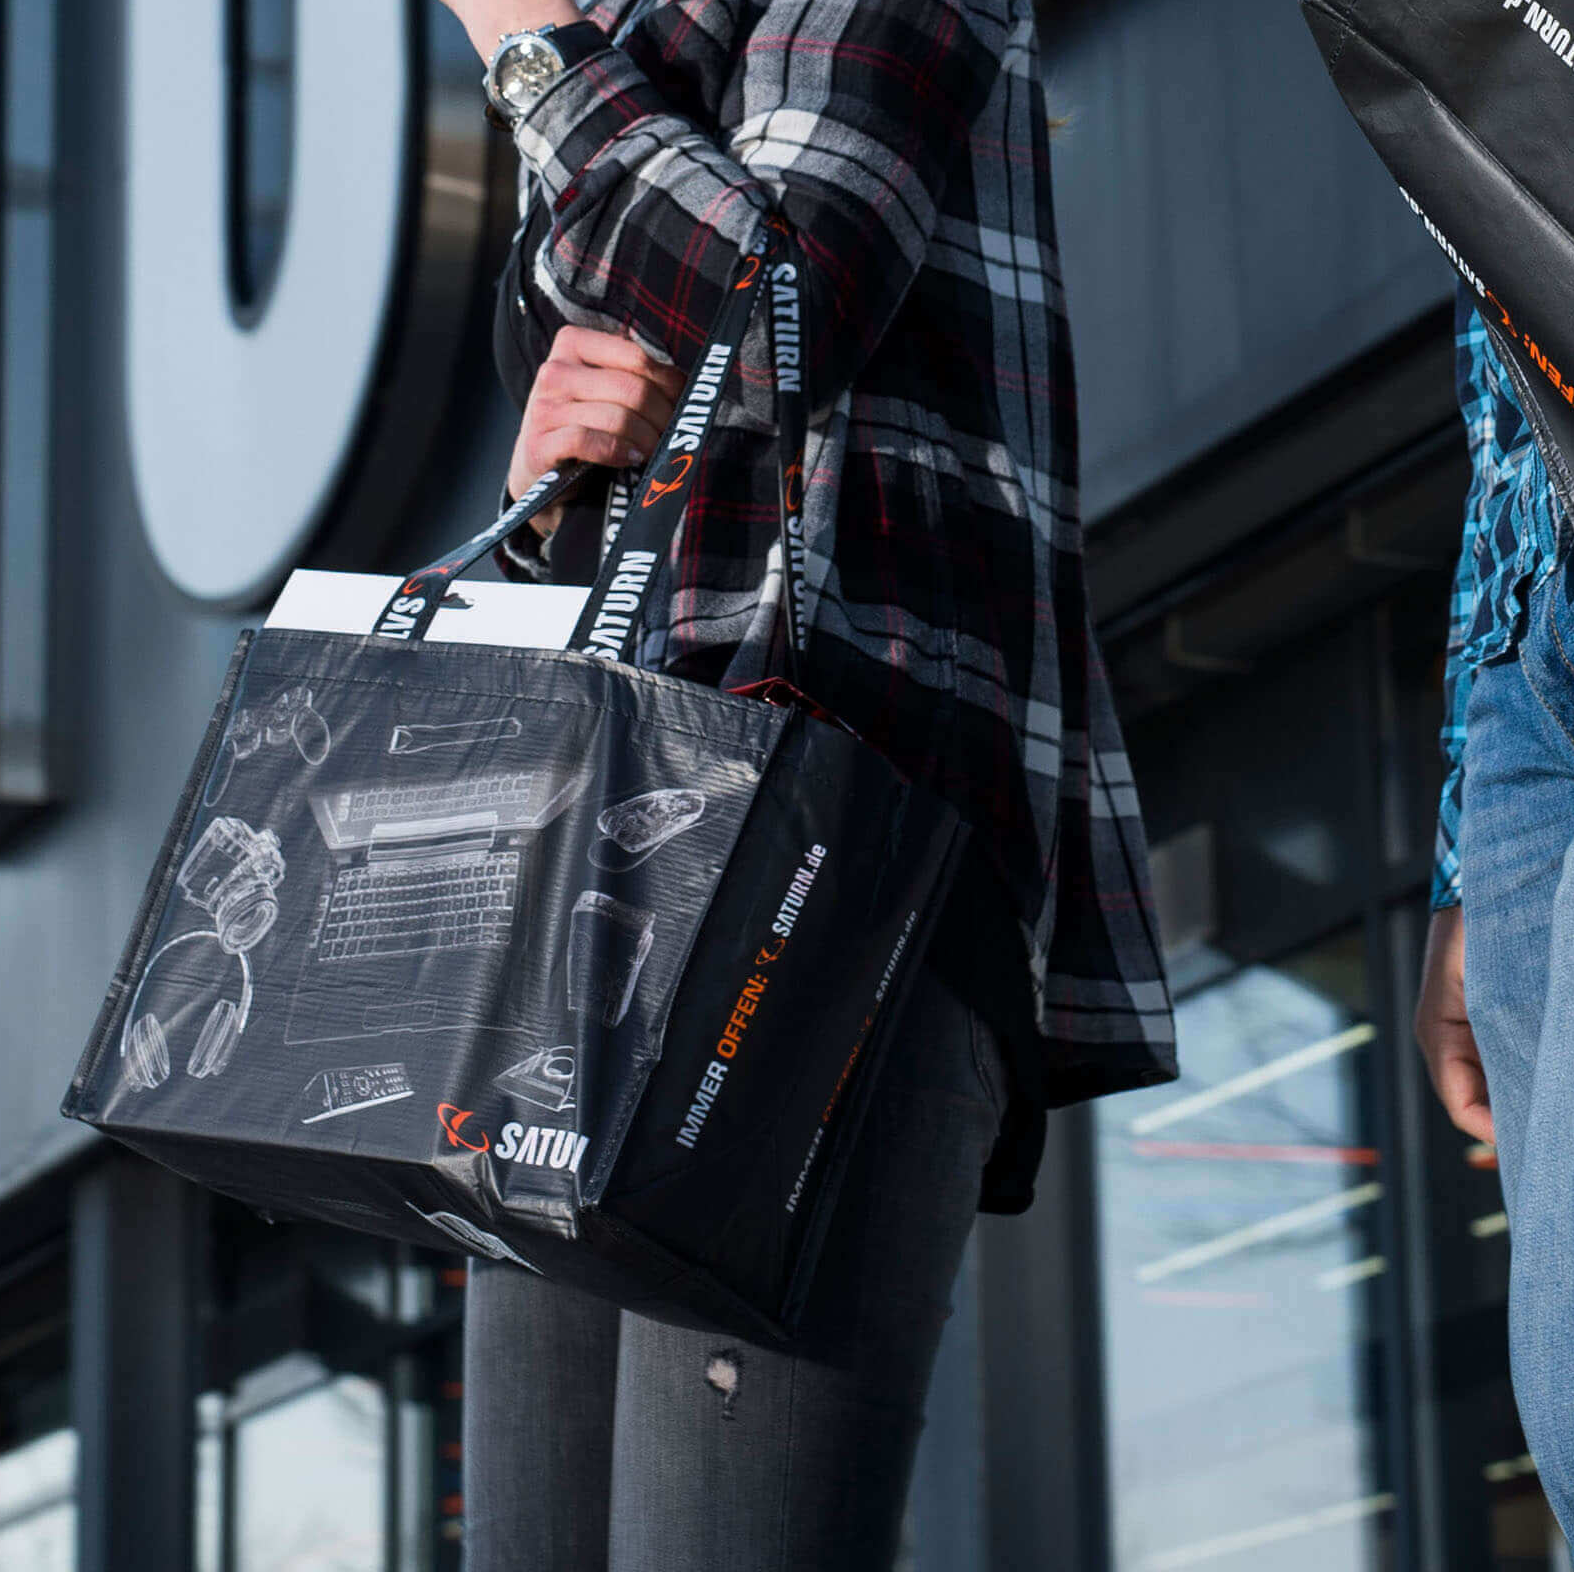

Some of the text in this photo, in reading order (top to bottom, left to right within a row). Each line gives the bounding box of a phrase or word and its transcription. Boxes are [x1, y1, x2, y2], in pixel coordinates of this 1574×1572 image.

[772, 262, 802, 393] SATURN
[582, 550, 657, 662] SATURN
[675, 842, 828, 1150] IMMER OFFEN: SATURN.de
